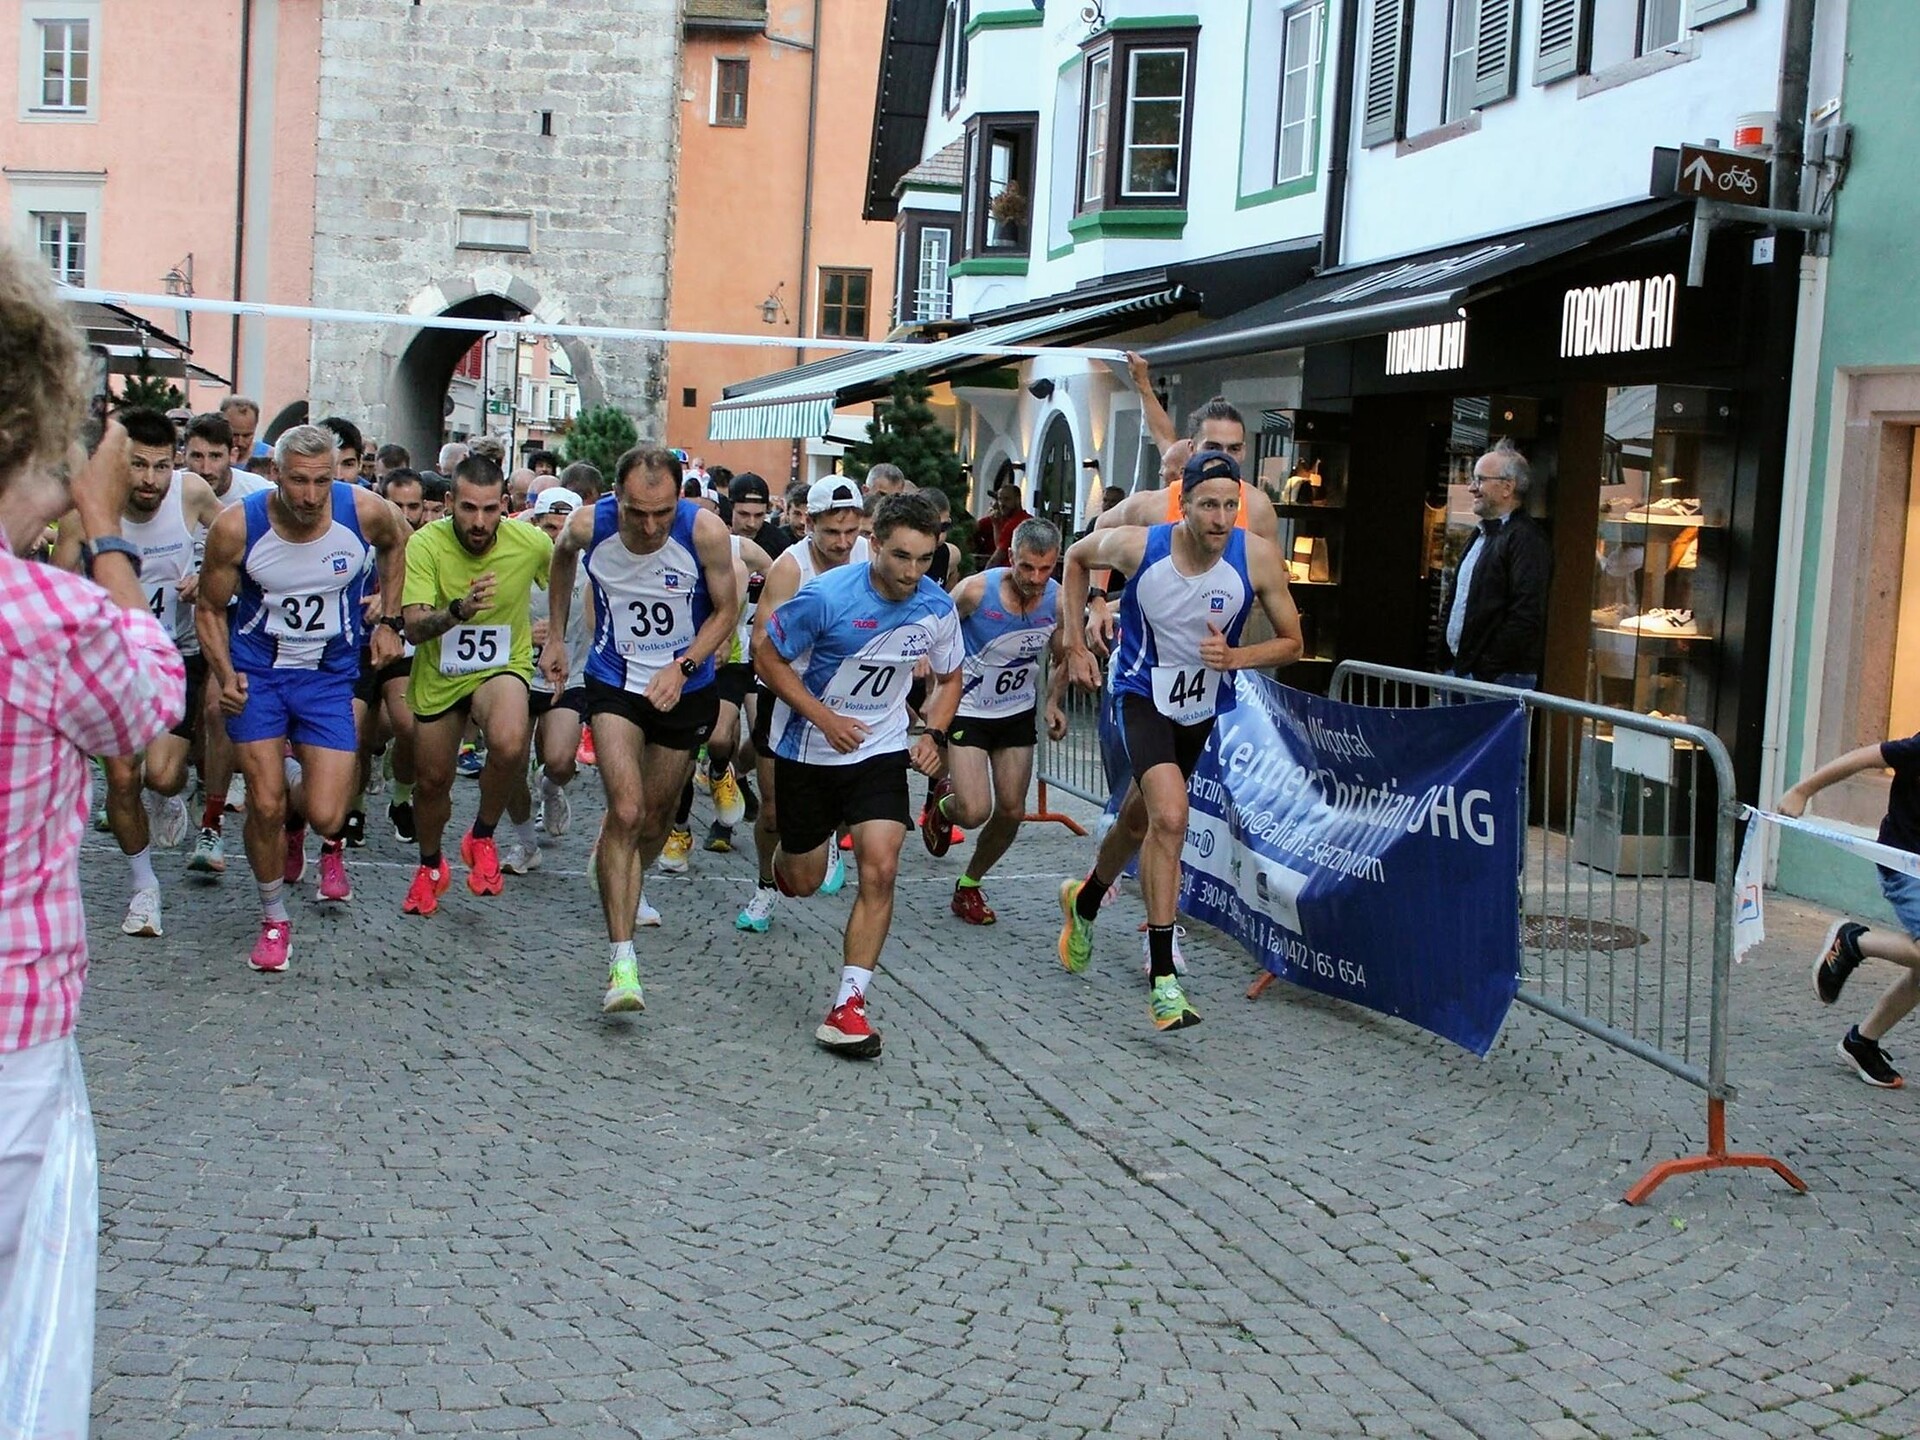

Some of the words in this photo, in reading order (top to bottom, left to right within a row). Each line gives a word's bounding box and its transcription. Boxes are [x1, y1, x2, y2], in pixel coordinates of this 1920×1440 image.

[281, 595, 325, 632] 32
[628, 601, 675, 637] 39
[457, 629, 497, 662] 55
[638, 636, 690, 653] Volksbank
[850, 664, 896, 698] 70
[995, 668, 1029, 696] 68
[1169, 668, 1206, 708] 44
[844, 701, 889, 711] Volksbank
[1307, 714, 1376, 764] Wipptal
[1218, 724, 1317, 808] Leitner
[1316, 767, 1416, 831] Christian
[1406, 784, 1495, 846] OHG
[1198, 880, 1228, 912] 39049
[1267, 926, 1284, 956] Fax
[1310, 950, 1335, 979] 765
[1338, 958, 1367, 988] 654
